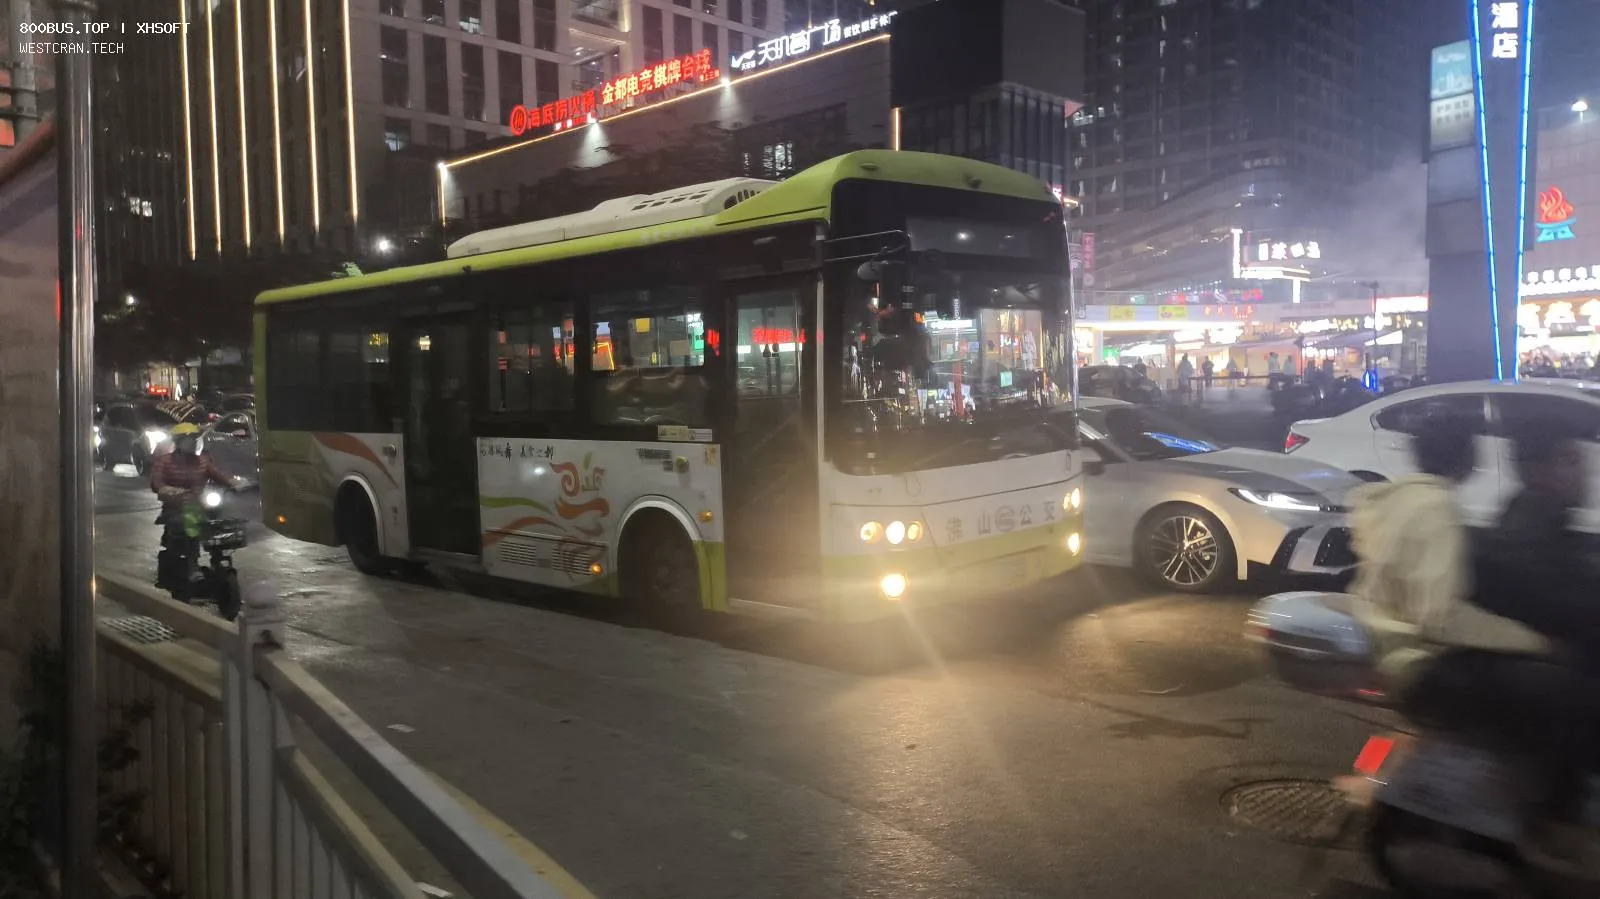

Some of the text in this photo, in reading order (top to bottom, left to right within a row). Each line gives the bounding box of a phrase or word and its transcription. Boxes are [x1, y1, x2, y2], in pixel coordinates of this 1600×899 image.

[602, 48, 712, 105] 金都电竞棋牌台球
